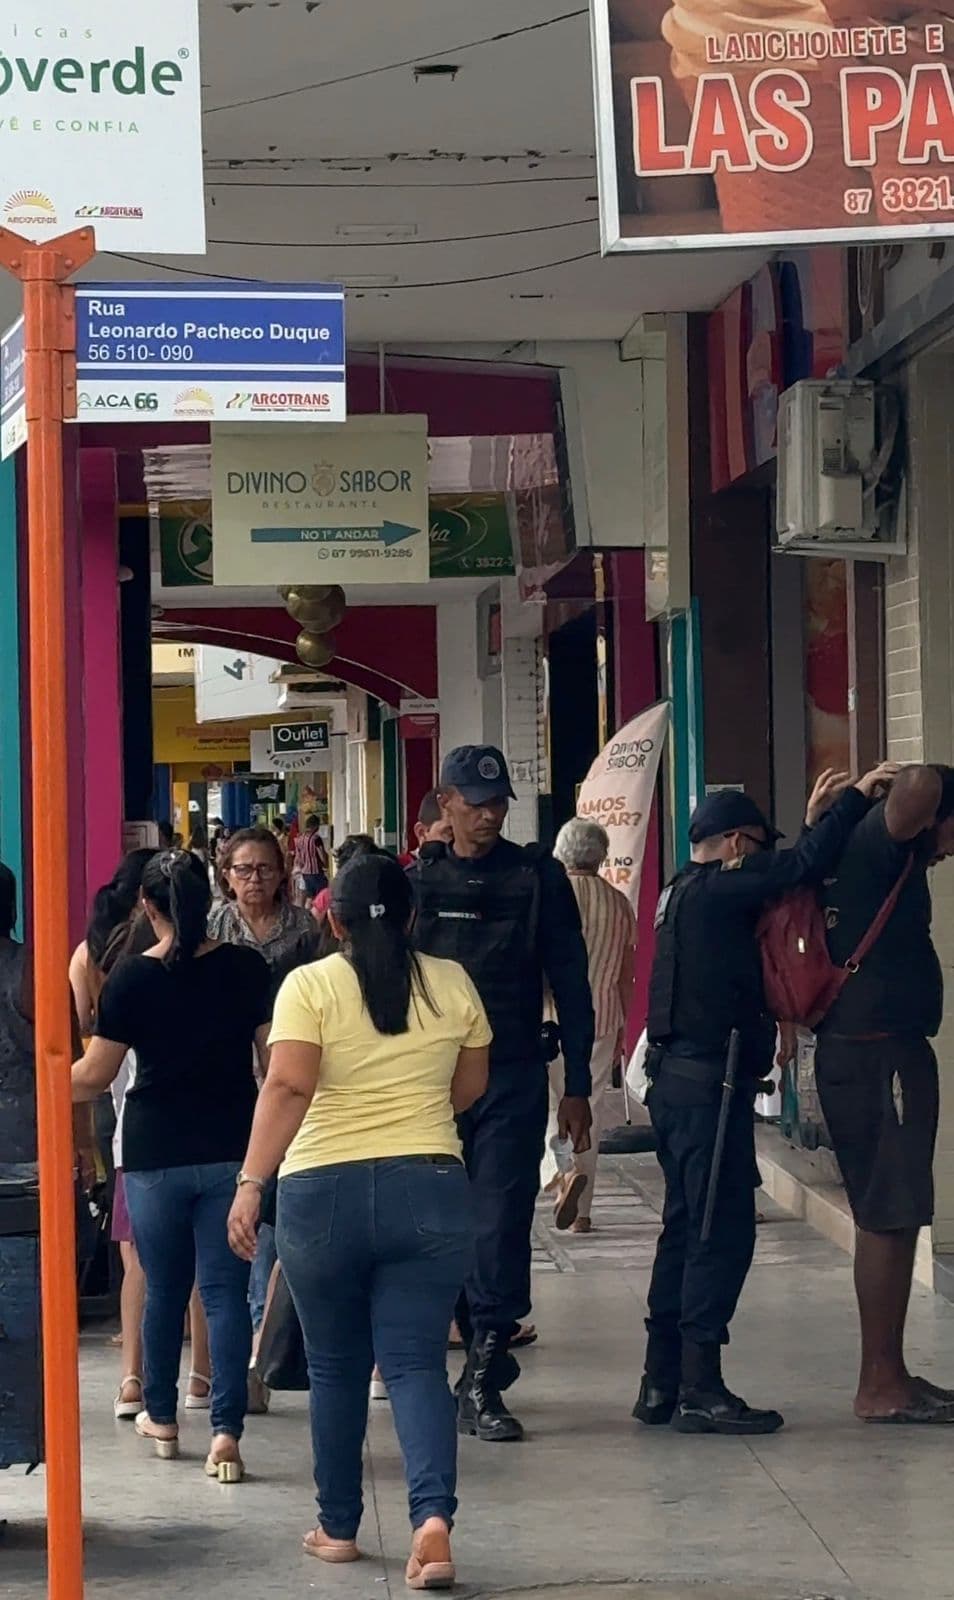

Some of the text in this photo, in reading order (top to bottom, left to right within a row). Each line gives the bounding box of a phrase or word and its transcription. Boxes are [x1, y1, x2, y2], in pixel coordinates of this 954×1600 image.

[705, 24, 944, 62] LANCHONETE E
[33, 119, 42, 131] E
[55, 119, 139, 134] CONFIA
[630, 67, 813, 177] LAS
[844, 188, 872, 214] 87
[88, 300, 125, 316] Rua
[88, 323, 330, 341] Leonardo Pacheco Duque
[88, 345, 110, 361] 56
[160, 345, 193, 361] 090
[252, 393, 330, 406] ARCOTRANS
[227, 470, 411, 494] DIVINO SABOR
[262, 500, 377, 509] RESTAURANTE
[301, 531, 319, 540] NO
[335, 530, 379, 540] ANDAR
[277, 727, 324, 742] Outlet
[614, 857, 633, 866] NO
